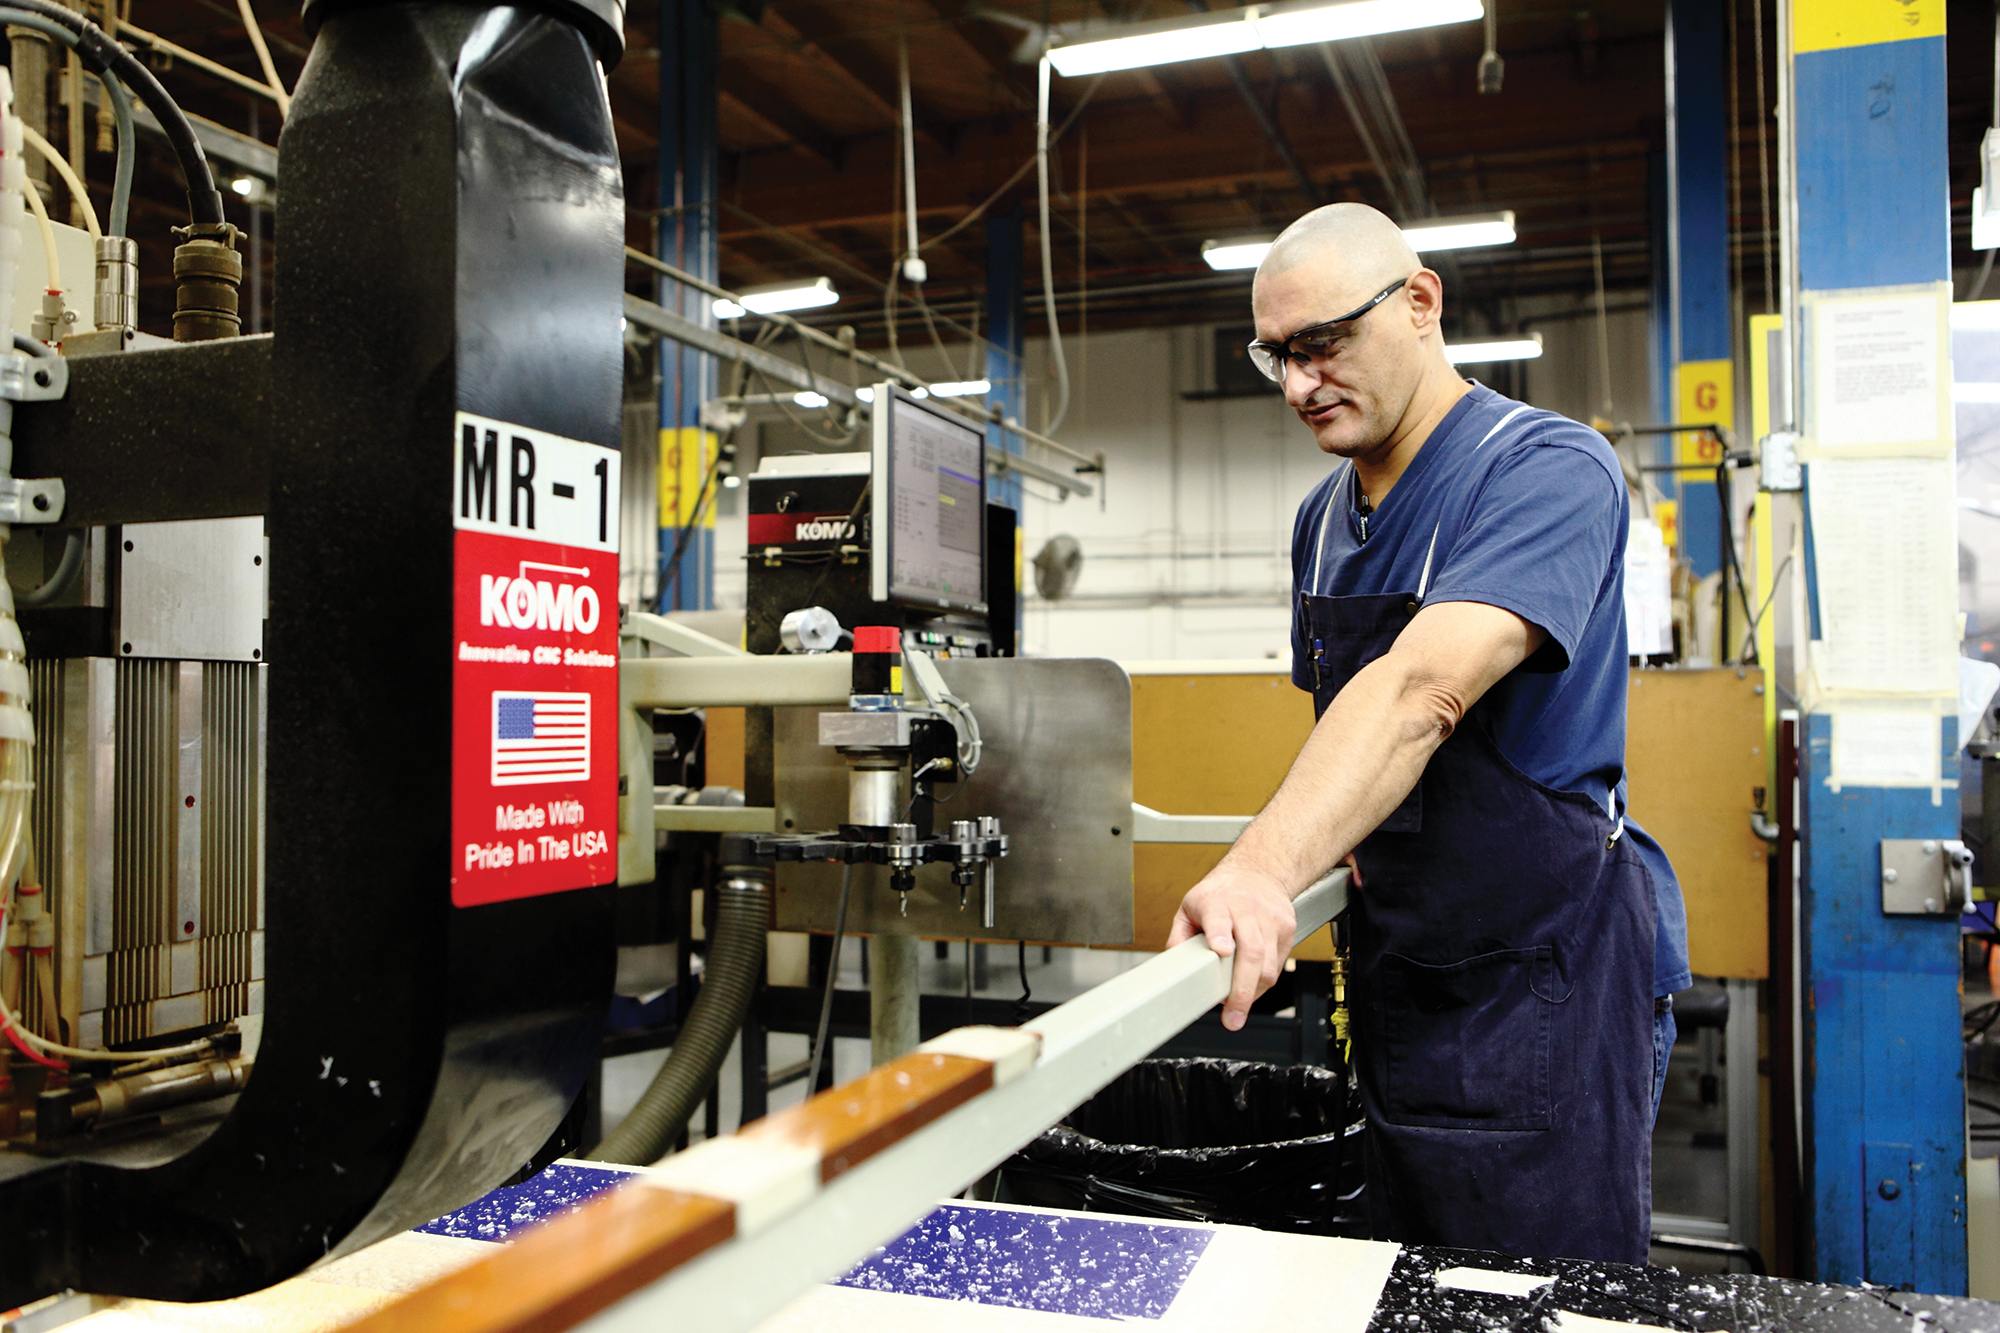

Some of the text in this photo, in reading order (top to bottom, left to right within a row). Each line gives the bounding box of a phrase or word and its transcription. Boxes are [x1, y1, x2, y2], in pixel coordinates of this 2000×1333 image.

[1695, 381, 1718, 412] G
[480, 574, 600, 635] KOMO
[458, 641, 616, 668] Innovative CNC Solutions
[496, 799, 585, 832] Made With
[465, 830, 609, 872] Pride In The USA
